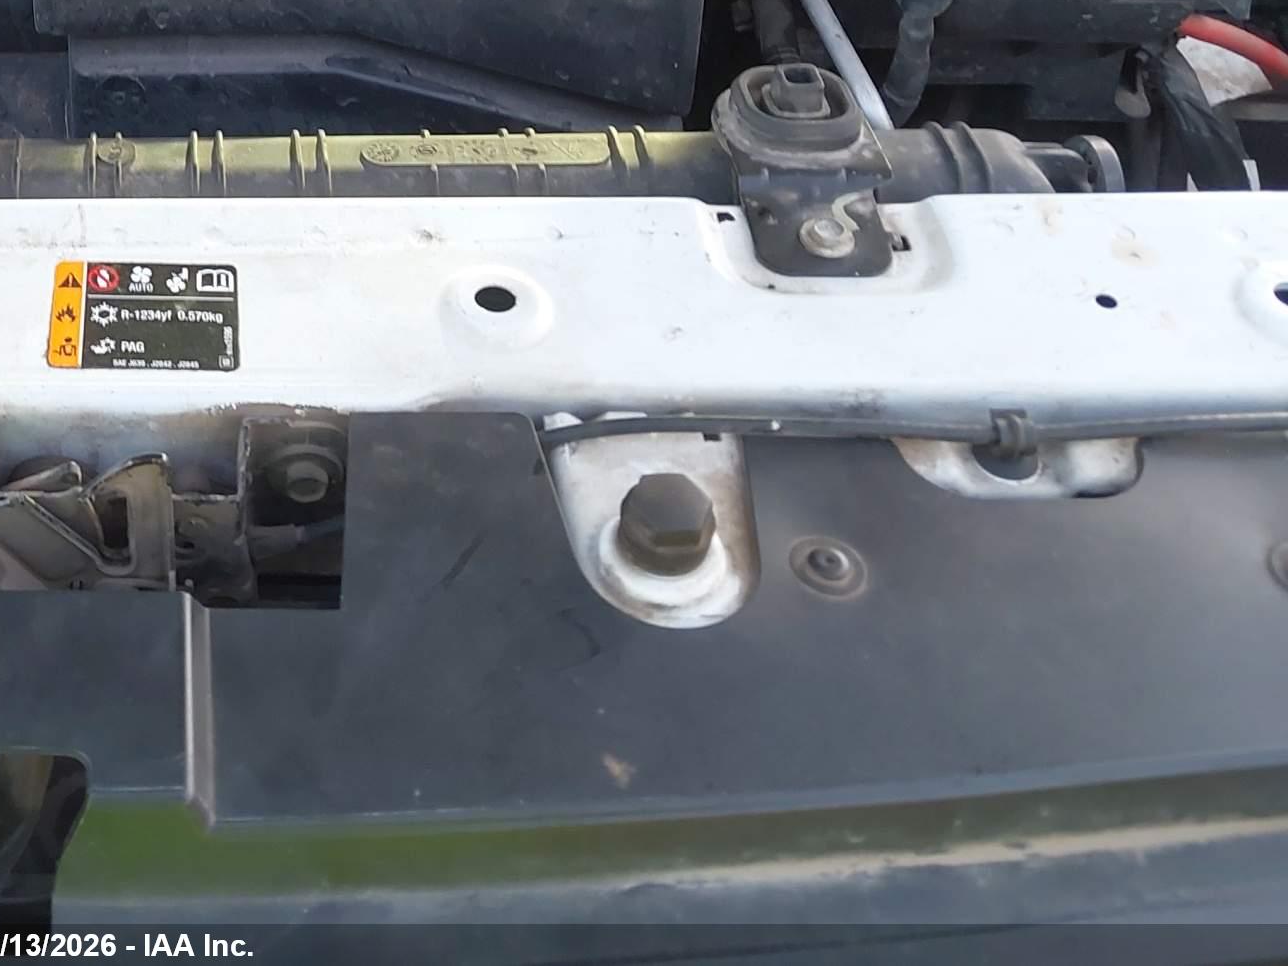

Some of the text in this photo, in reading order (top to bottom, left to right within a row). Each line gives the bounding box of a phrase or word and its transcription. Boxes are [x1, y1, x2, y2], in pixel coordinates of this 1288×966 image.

[128, 282, 154, 293] AUTO
[120, 309, 172, 323] R-1234yf
[120, 340, 145, 354] PAG
